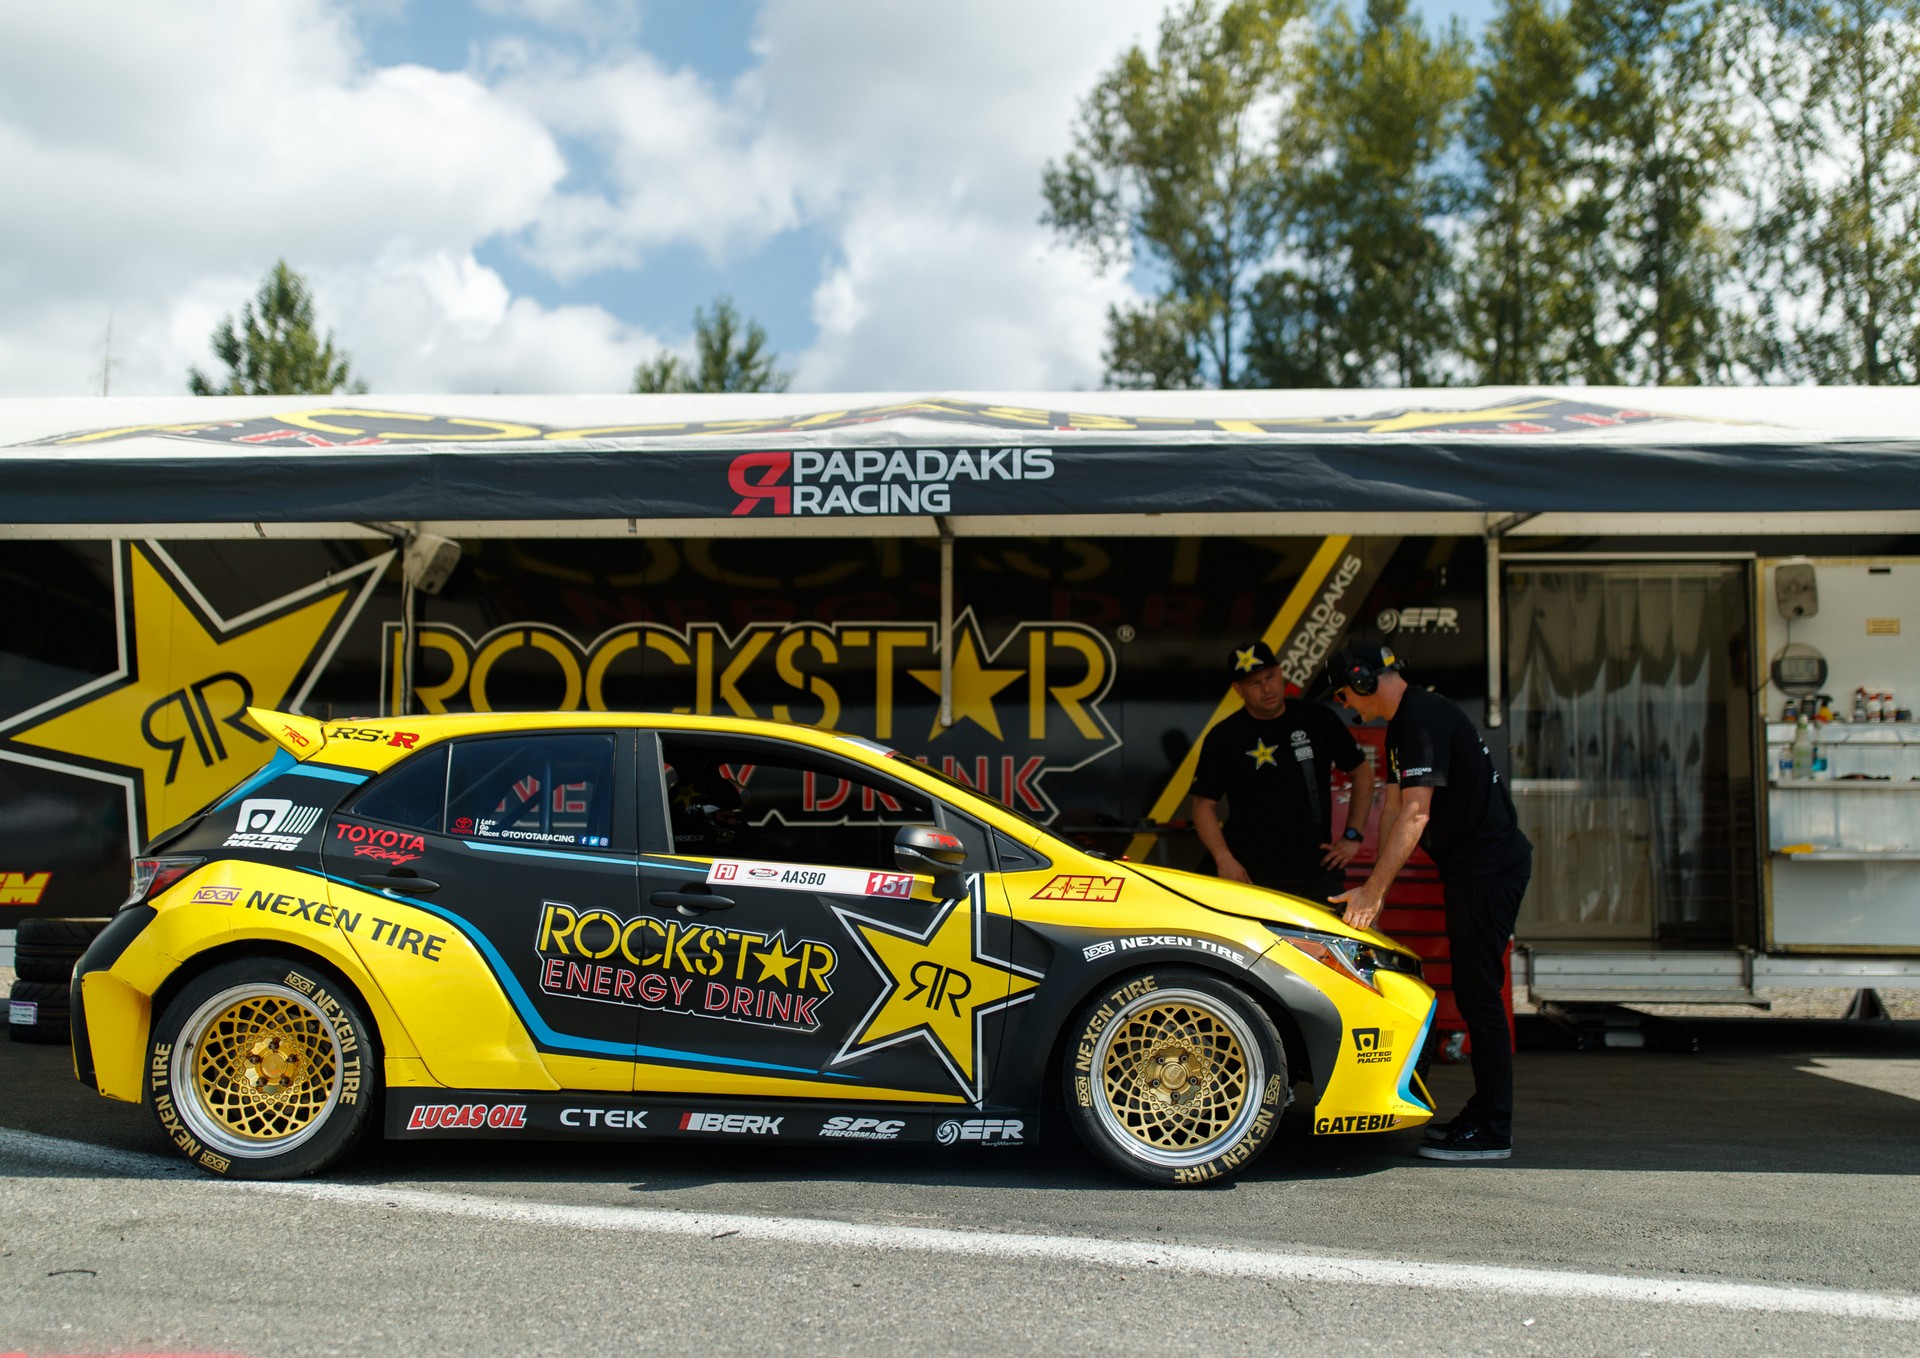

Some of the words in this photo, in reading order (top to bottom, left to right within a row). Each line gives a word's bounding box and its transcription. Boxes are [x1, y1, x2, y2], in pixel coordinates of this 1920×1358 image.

[793, 449, 1055, 483] PAPADAKIS
[793, 483, 950, 515] RACING
[1280, 554, 1362, 681] PAPADAKIS
[1399, 607, 1458, 628] EFR
[1291, 610, 1347, 688] RACING
[282, 725, 310, 748] TRD
[222, 839, 299, 852] RACING
[227, 833, 303, 844] MOTEGI
[337, 824, 425, 852] TOYOTA
[501, 830, 575, 843] @TOYOTARACING
[354, 845, 421, 866] Racing
[716, 865, 736, 880] FD
[781, 870, 826, 886] AASBO
[192, 888, 240, 903] NEXEN
[871, 874, 911, 895] 151
[245, 890, 362, 933] NEXEN
[370, 917, 447, 962] TIRE
[1120, 936, 1192, 951] NEXEN
[1197, 939, 1244, 965] TIRE
[545, 959, 692, 1006] ENERGY
[704, 982, 818, 1025] DRINK
[1076, 1004, 1115, 1072] NEXEN
[1111, 975, 1158, 1007] TIRE
[312, 989, 357, 1054] NEXEN
[339, 1055, 361, 1105] TIRE
[151, 1043, 172, 1091] TIRE
[155, 1095, 201, 1157] NEXEN
[407, 1105, 487, 1130] LUCAS
[487, 1104, 527, 1129] OIL
[559, 1108, 649, 1129] CTEK
[700, 1113, 785, 1135] BERK
[823, 1116, 906, 1133] SPC
[1316, 1114, 1396, 1134] GATEBIL
[819, 1129, 898, 1140] PERFORMANCE
[960, 1119, 1024, 1140] EFR
[1221, 1106, 1274, 1170] NEXEN
[1174, 1162, 1223, 1185] TIRE
